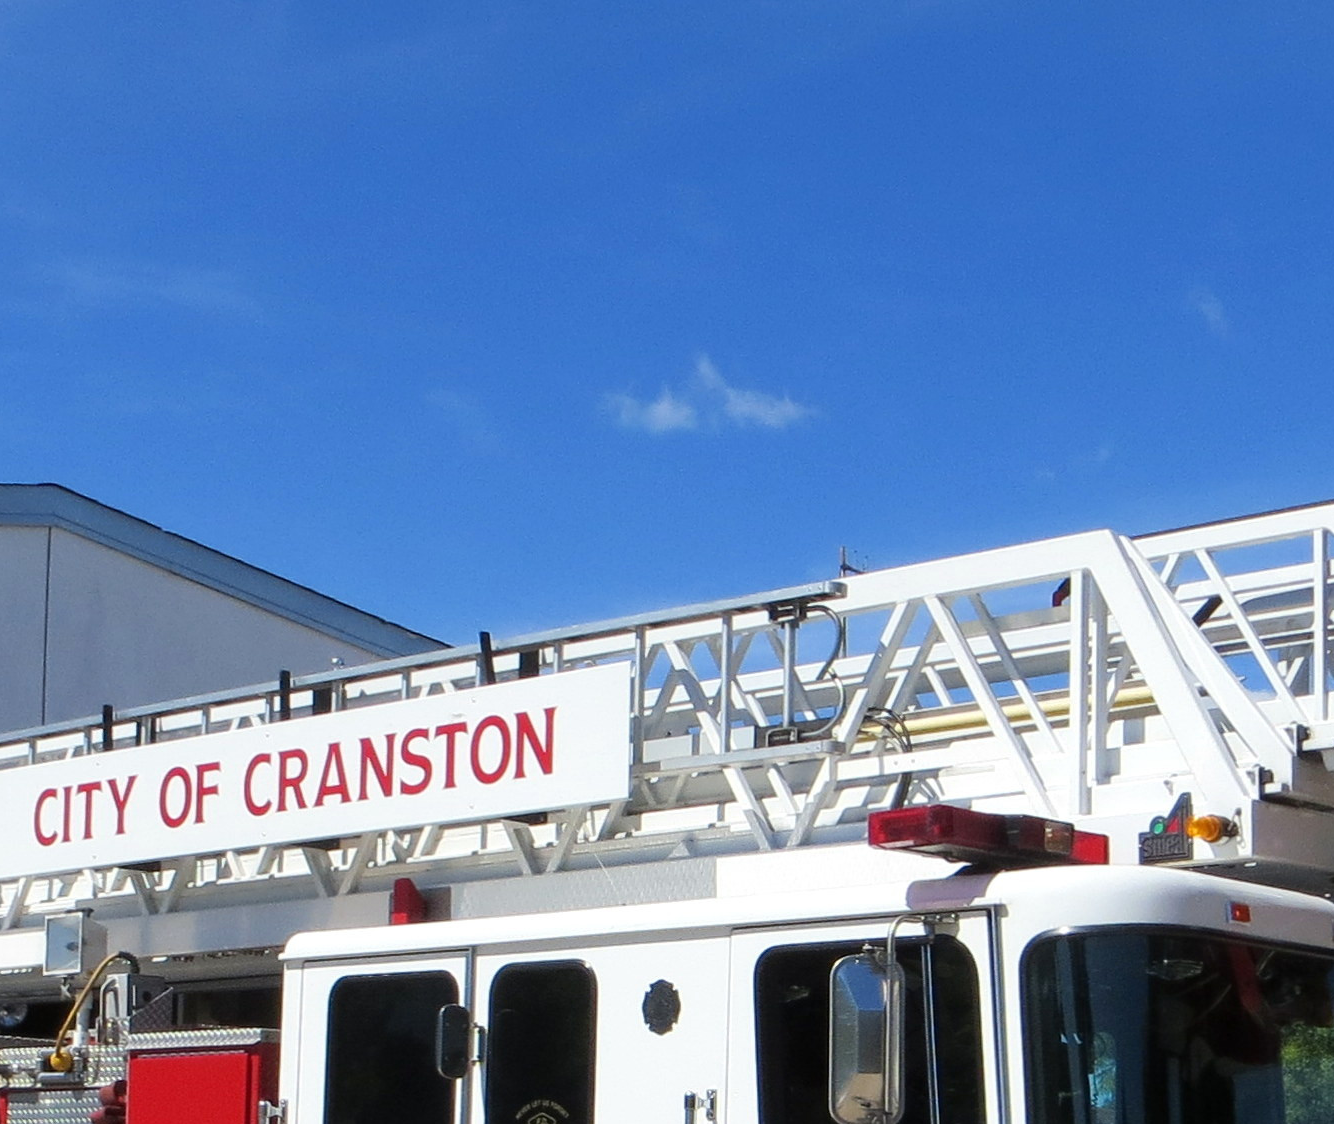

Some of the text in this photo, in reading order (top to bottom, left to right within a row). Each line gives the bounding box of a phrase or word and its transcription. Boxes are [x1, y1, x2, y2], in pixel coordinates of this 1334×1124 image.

[34, 706, 558, 848] CITY OF CRANSTON
